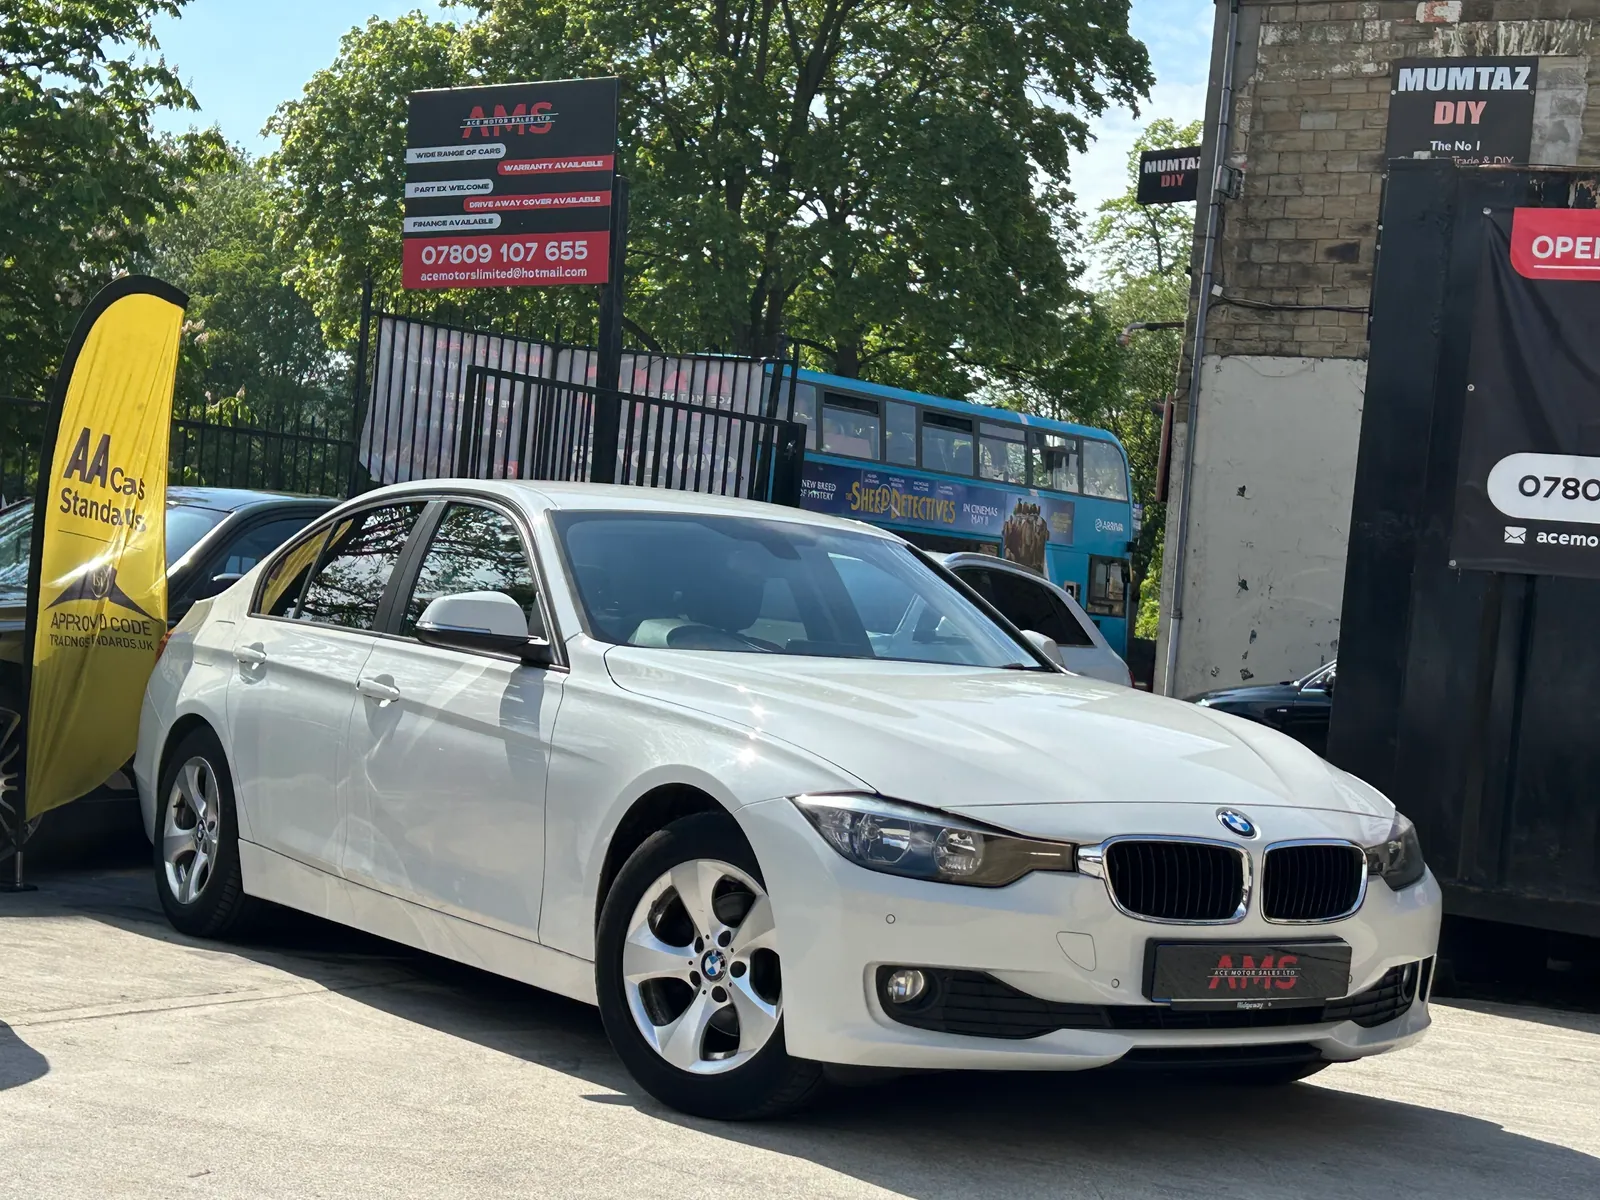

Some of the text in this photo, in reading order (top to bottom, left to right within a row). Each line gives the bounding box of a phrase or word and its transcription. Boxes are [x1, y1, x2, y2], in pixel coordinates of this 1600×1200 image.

[1398, 66, 1531, 92] MUMTAZ
[462, 102, 552, 138] AMS
[1434, 101, 1487, 124] DIY
[1430, 140, 1452, 151] The
[1454, 140, 1472, 151] No
[504, 160, 604, 171] WARRANTY AVAILABLE
[448, 183, 489, 191] WELCOME
[1161, 174, 1184, 187] DIY
[522, 198, 552, 206] COVER
[553, 195, 601, 204] AVAILABLE
[413, 217, 494, 228] FINANCE AVAILABLE
[421, 240, 588, 265] 07809 107 655
[420, 266, 588, 282] acemotorslimited@hotmail.com
[64, 427, 111, 488] AA
[802, 480, 836, 492] NEW BREED
[851, 481, 890, 514] SHEEP
[890, 488, 956, 524] DETECTIVES
[963, 502, 998, 517] IN CINEMAS
[971, 514, 982, 525] MAY
[1536, 531, 1599, 547] acemo
[110, 617, 152, 636] CODE
[1208, 955, 1298, 989] AMS
